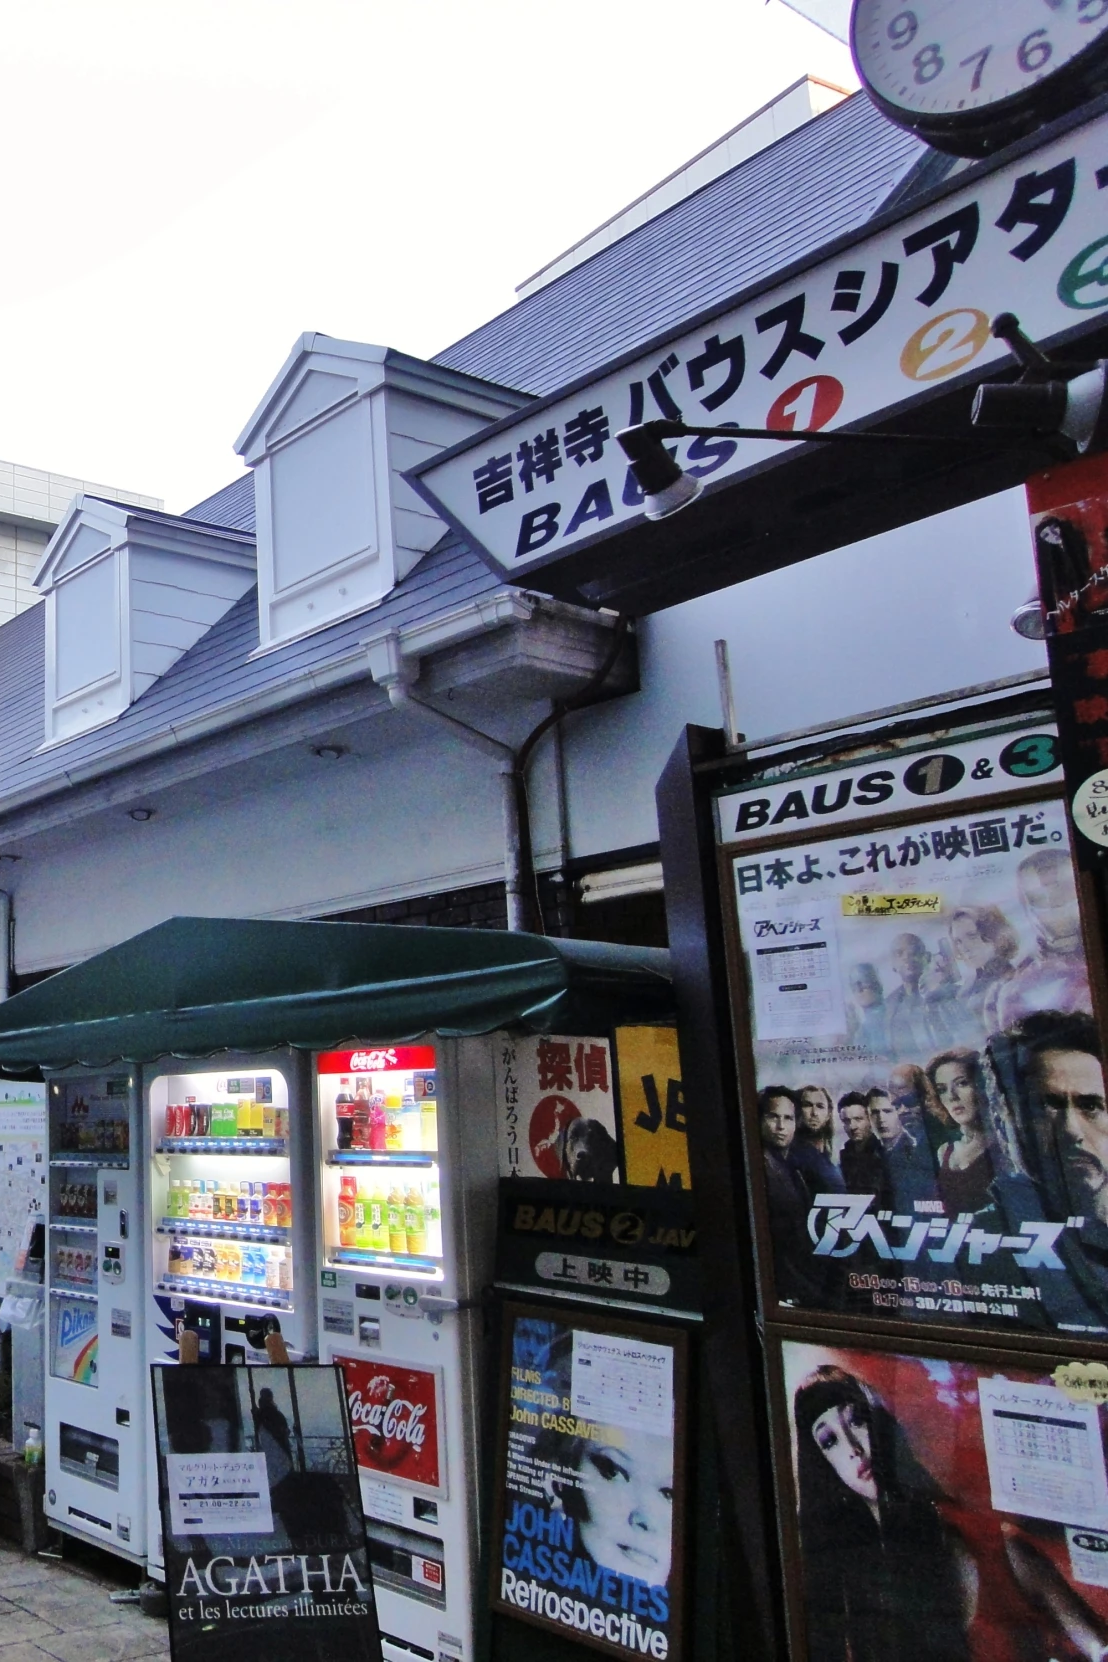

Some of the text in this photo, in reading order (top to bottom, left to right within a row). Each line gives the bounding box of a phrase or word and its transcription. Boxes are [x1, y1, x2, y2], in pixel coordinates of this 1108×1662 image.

[887, 10, 918, 51] 9
[1017, 28, 1053, 73] 6
[912, 43, 945, 85] 8
[958, 44, 992, 92] 7
[472, 404, 611, 515] 吉祥寺
[628, 157, 1108, 428] バウスシアタ
[735, 771, 895, 832] BAUS
[971, 758, 994, 780] &
[737, 812, 1063, 896] 日本よ、これが映画だ。
[537, 1040, 610, 1093] 探偵
[513, 1205, 605, 1237] BAUS
[807, 1194, 1085, 1270] アベンジャーズ
[553, 1257, 649, 1289] 上映中
[511, 1366, 541, 1386] FILMS
[511, 1386, 559, 1410] DIRECTED
[348, 1391, 428, 1446] Coca-Cola
[509, 1404, 539, 1428] John
[506, 1500, 574, 1551] JOHN
[176, 1554, 368, 1597] AGATHA
[503, 1534, 669, 1624] CASSAVETES
[179, 1597, 368, 1620] et les lectures illimitées
[501, 1567, 669, 1661] Retrospective
